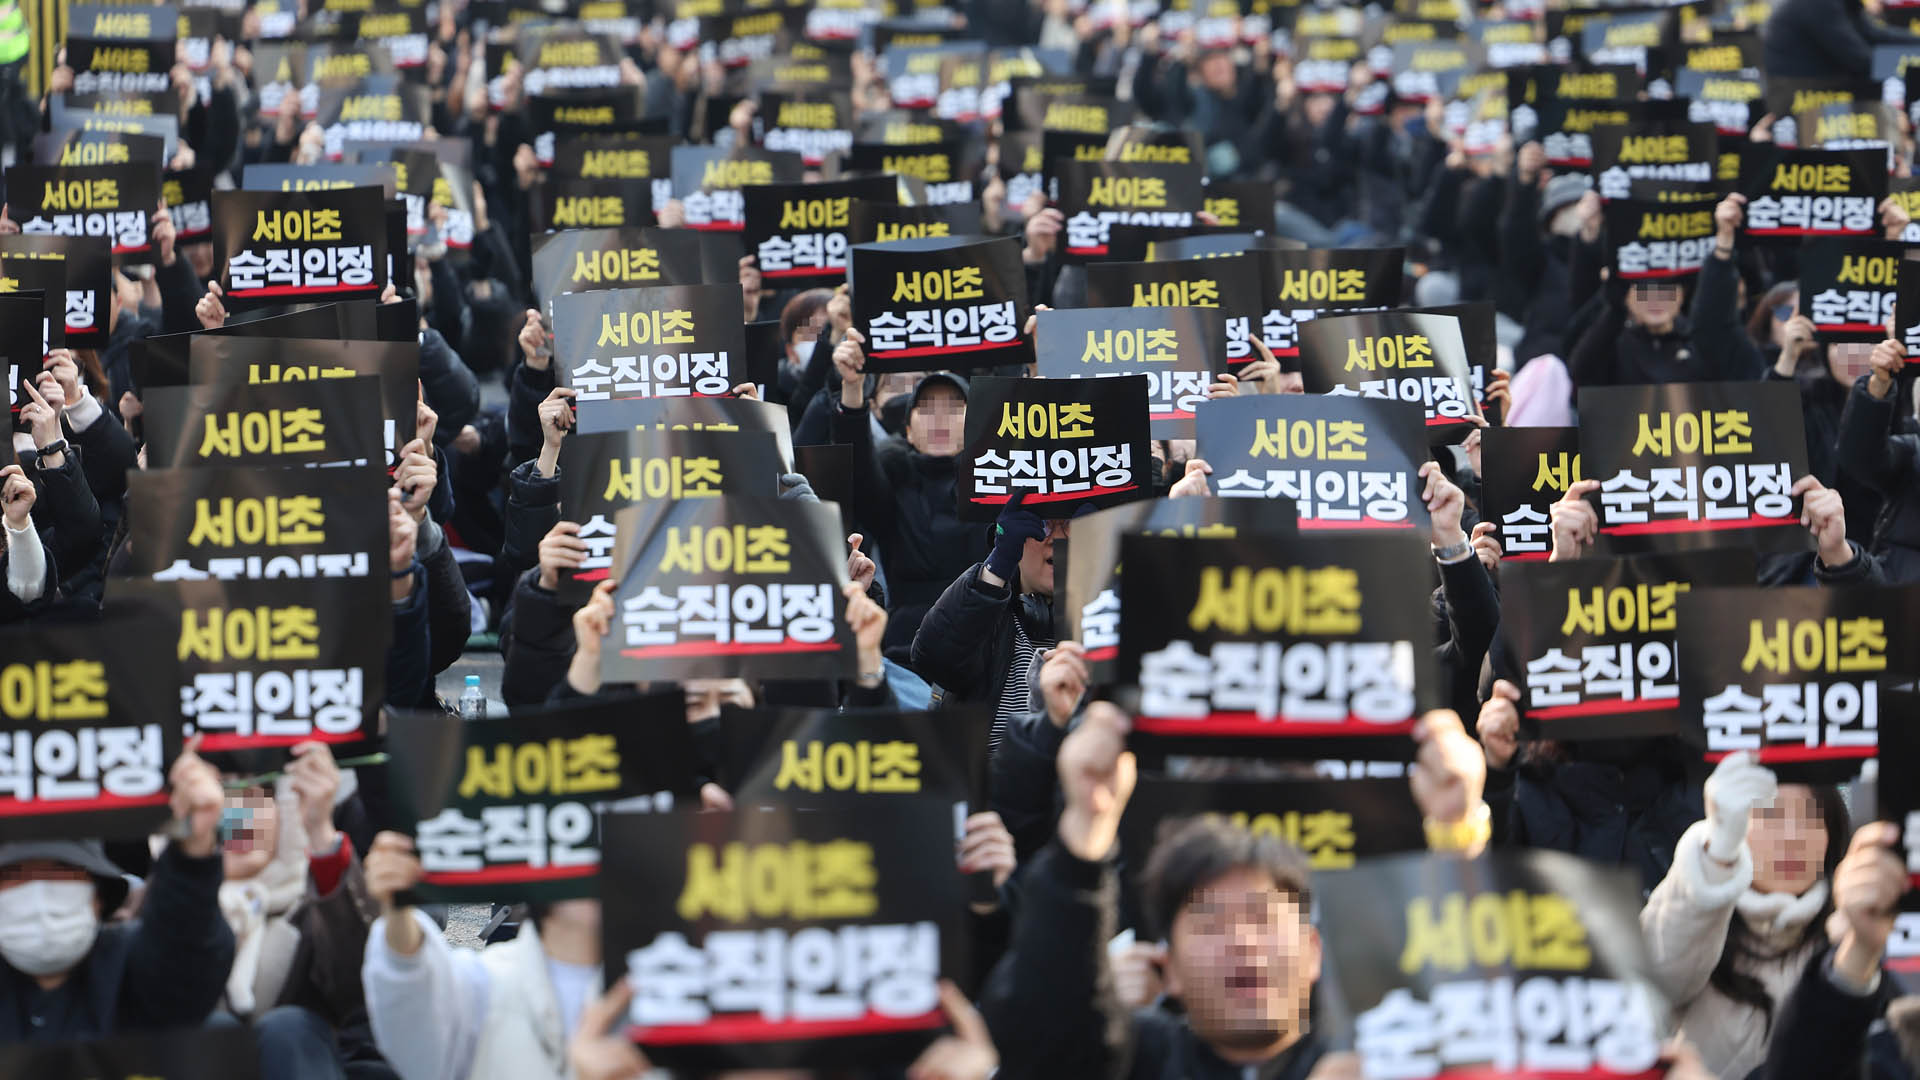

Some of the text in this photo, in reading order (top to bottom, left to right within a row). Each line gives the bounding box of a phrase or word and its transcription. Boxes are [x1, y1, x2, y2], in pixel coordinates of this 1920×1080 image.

[582, 151, 648, 177] 서이초
[1619, 136, 1688, 162] 서이초
[42, 179, 119, 210] 서이초
[1088, 177, 1166, 207] 서이초
[1771, 165, 1850, 192] 서이초
[253, 209, 342, 242] 서이초
[553, 197, 624, 224] 서이초
[1640, 212, 1711, 238] 서이초
[1748, 196, 1874, 230] 순직인정
[229, 245, 373, 288] 순직인정
[573, 248, 660, 283] 서이초
[892, 267, 984, 302] 서이초
[1280, 269, 1365, 301] 서이초
[1837, 256, 1898, 285] 서이
[1132, 280, 1219, 308] 서이초
[598, 309, 695, 347] 서이초
[870, 301, 1017, 349] 순직인정
[1082, 328, 1182, 363] 서이초
[572, 351, 730, 400] 순직인정
[1344, 335, 1434, 371] 서이초
[199, 408, 325, 456] 서이초
[997, 402, 1094, 439] 서이초
[1249, 419, 1368, 460] 서이초
[1632, 410, 1752, 456] 서이초
[604, 456, 723, 500] 서이초
[974, 443, 1131, 494] 순직인정
[1601, 463, 1793, 523] 순직인정
[189, 496, 324, 546] 서이초
[660, 525, 790, 574] 서이초
[622, 584, 835, 645] 순직인정
[1191, 567, 1361, 634] 서이초
[178, 606, 319, 661] 서이초
[1742, 617, 1887, 673] 서이초
[0, 660, 107, 720] 이초
[1139, 641, 1415, 722] 순직인정
[1527, 641, 1679, 707] 순직인
[1703, 681, 1878, 752] 순직인
[0, 724, 163, 800] 직인정
[460, 734, 620, 797] 서이초
[776, 741, 920, 792] 서이초
[680, 841, 876, 921] 서이초
[1403, 891, 1590, 971] 서이초
[627, 922, 941, 1025] 순직인정
[1355, 978, 1660, 1072] 순직인정
